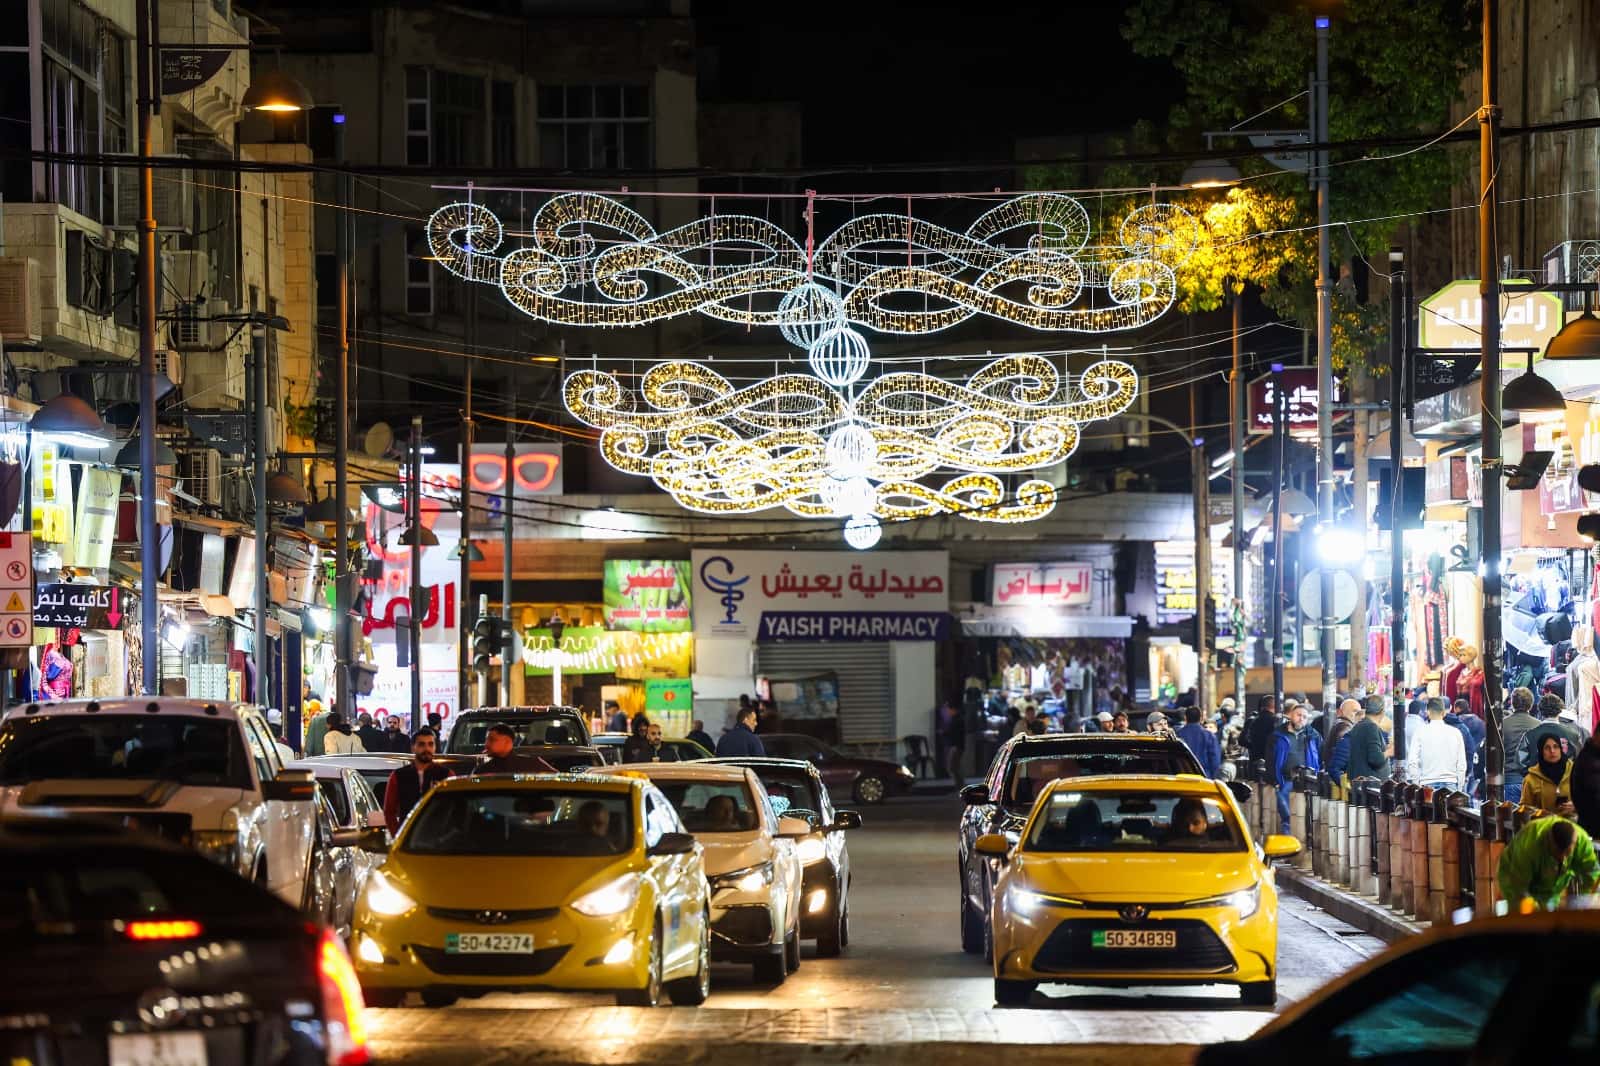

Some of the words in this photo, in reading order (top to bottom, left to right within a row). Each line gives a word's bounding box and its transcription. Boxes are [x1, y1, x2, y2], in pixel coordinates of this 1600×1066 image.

[1434, 297, 1483, 326] لله
[622, 566, 676, 596] عصير
[762, 562, 843, 599] يعيش
[848, 564, 944, 599] صيدلية
[32, 587, 65, 610] نبض
[69, 589, 111, 611] كافيه
[54, 613, 88, 627] يوجد
[764, 616, 825, 637] YAISH
[829, 616, 940, 637] PHARMACY
